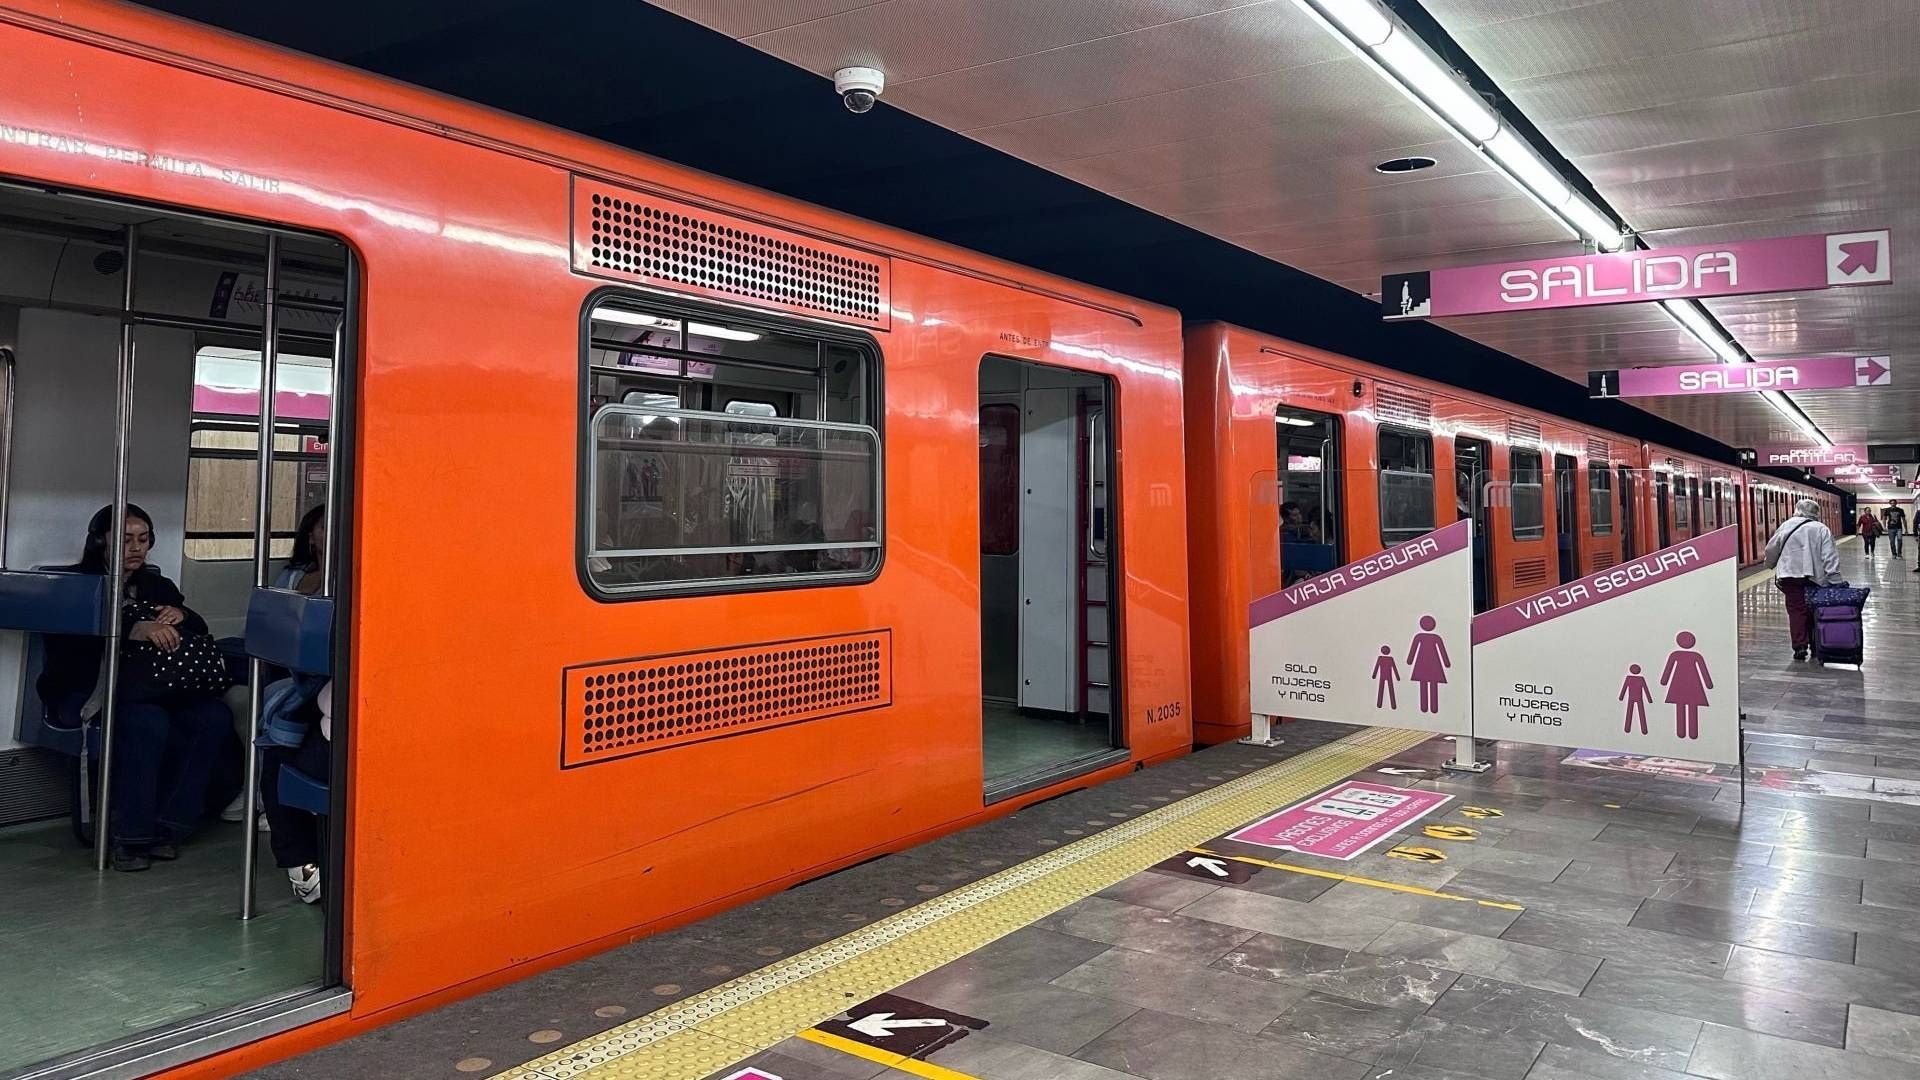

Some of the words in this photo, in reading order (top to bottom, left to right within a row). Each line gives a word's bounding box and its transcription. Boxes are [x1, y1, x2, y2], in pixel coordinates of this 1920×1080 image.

[105, 144, 206, 178] PERMITA
[221, 168, 281, 193] SALIR
[1500, 251, 1738, 303] SALIDA
[1000, 332, 1020, 343] ANTES
[1680, 366, 1799, 390] SALIDA
[1285, 573, 1346, 604] VIAJA
[1350, 537, 1439, 581] SEGURA
[1516, 584, 1590, 620] VIAJA
[1593, 546, 1700, 594] SEGURA
[1284, 663, 1317, 674] SOLO
[1271, 676, 1331, 689] MUJERES
[1514, 683, 1553, 695] SOLO
[1278, 690, 1286, 699] Y
[1289, 690, 1325, 703] NIÑOS
[1499, 697, 1570, 712] MUJERES
[1506, 712, 1516, 722] Y
[1520, 713, 1562, 727] NIÑOS
